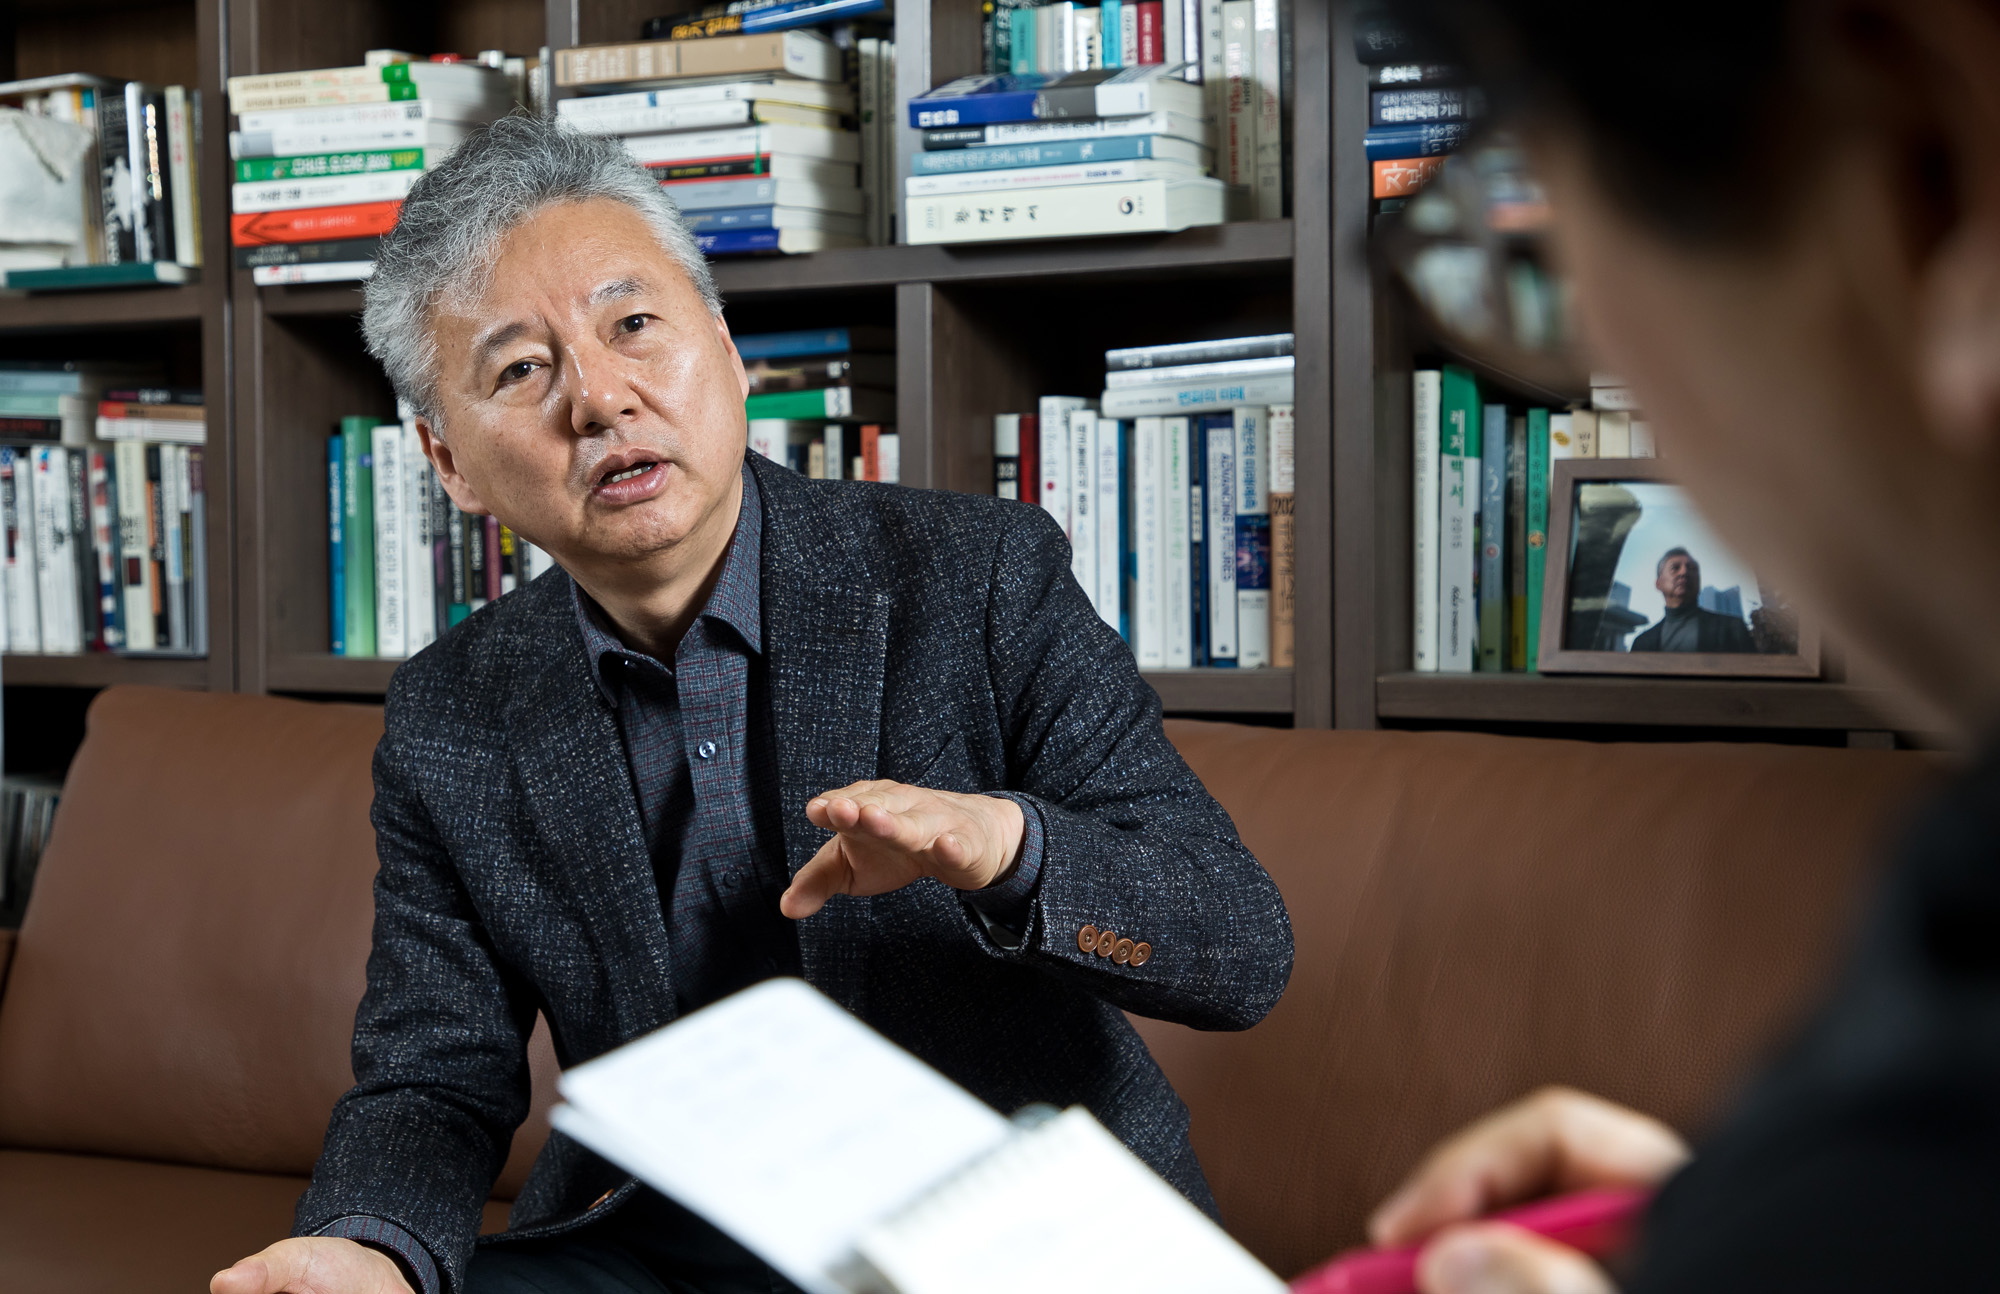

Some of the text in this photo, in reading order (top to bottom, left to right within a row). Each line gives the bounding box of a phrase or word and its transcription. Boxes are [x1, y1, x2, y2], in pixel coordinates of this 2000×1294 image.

[1380, 103, 1462, 122] 대한민국의 기회
[1221, 453, 1233, 582] ADVANCING FUTURES
